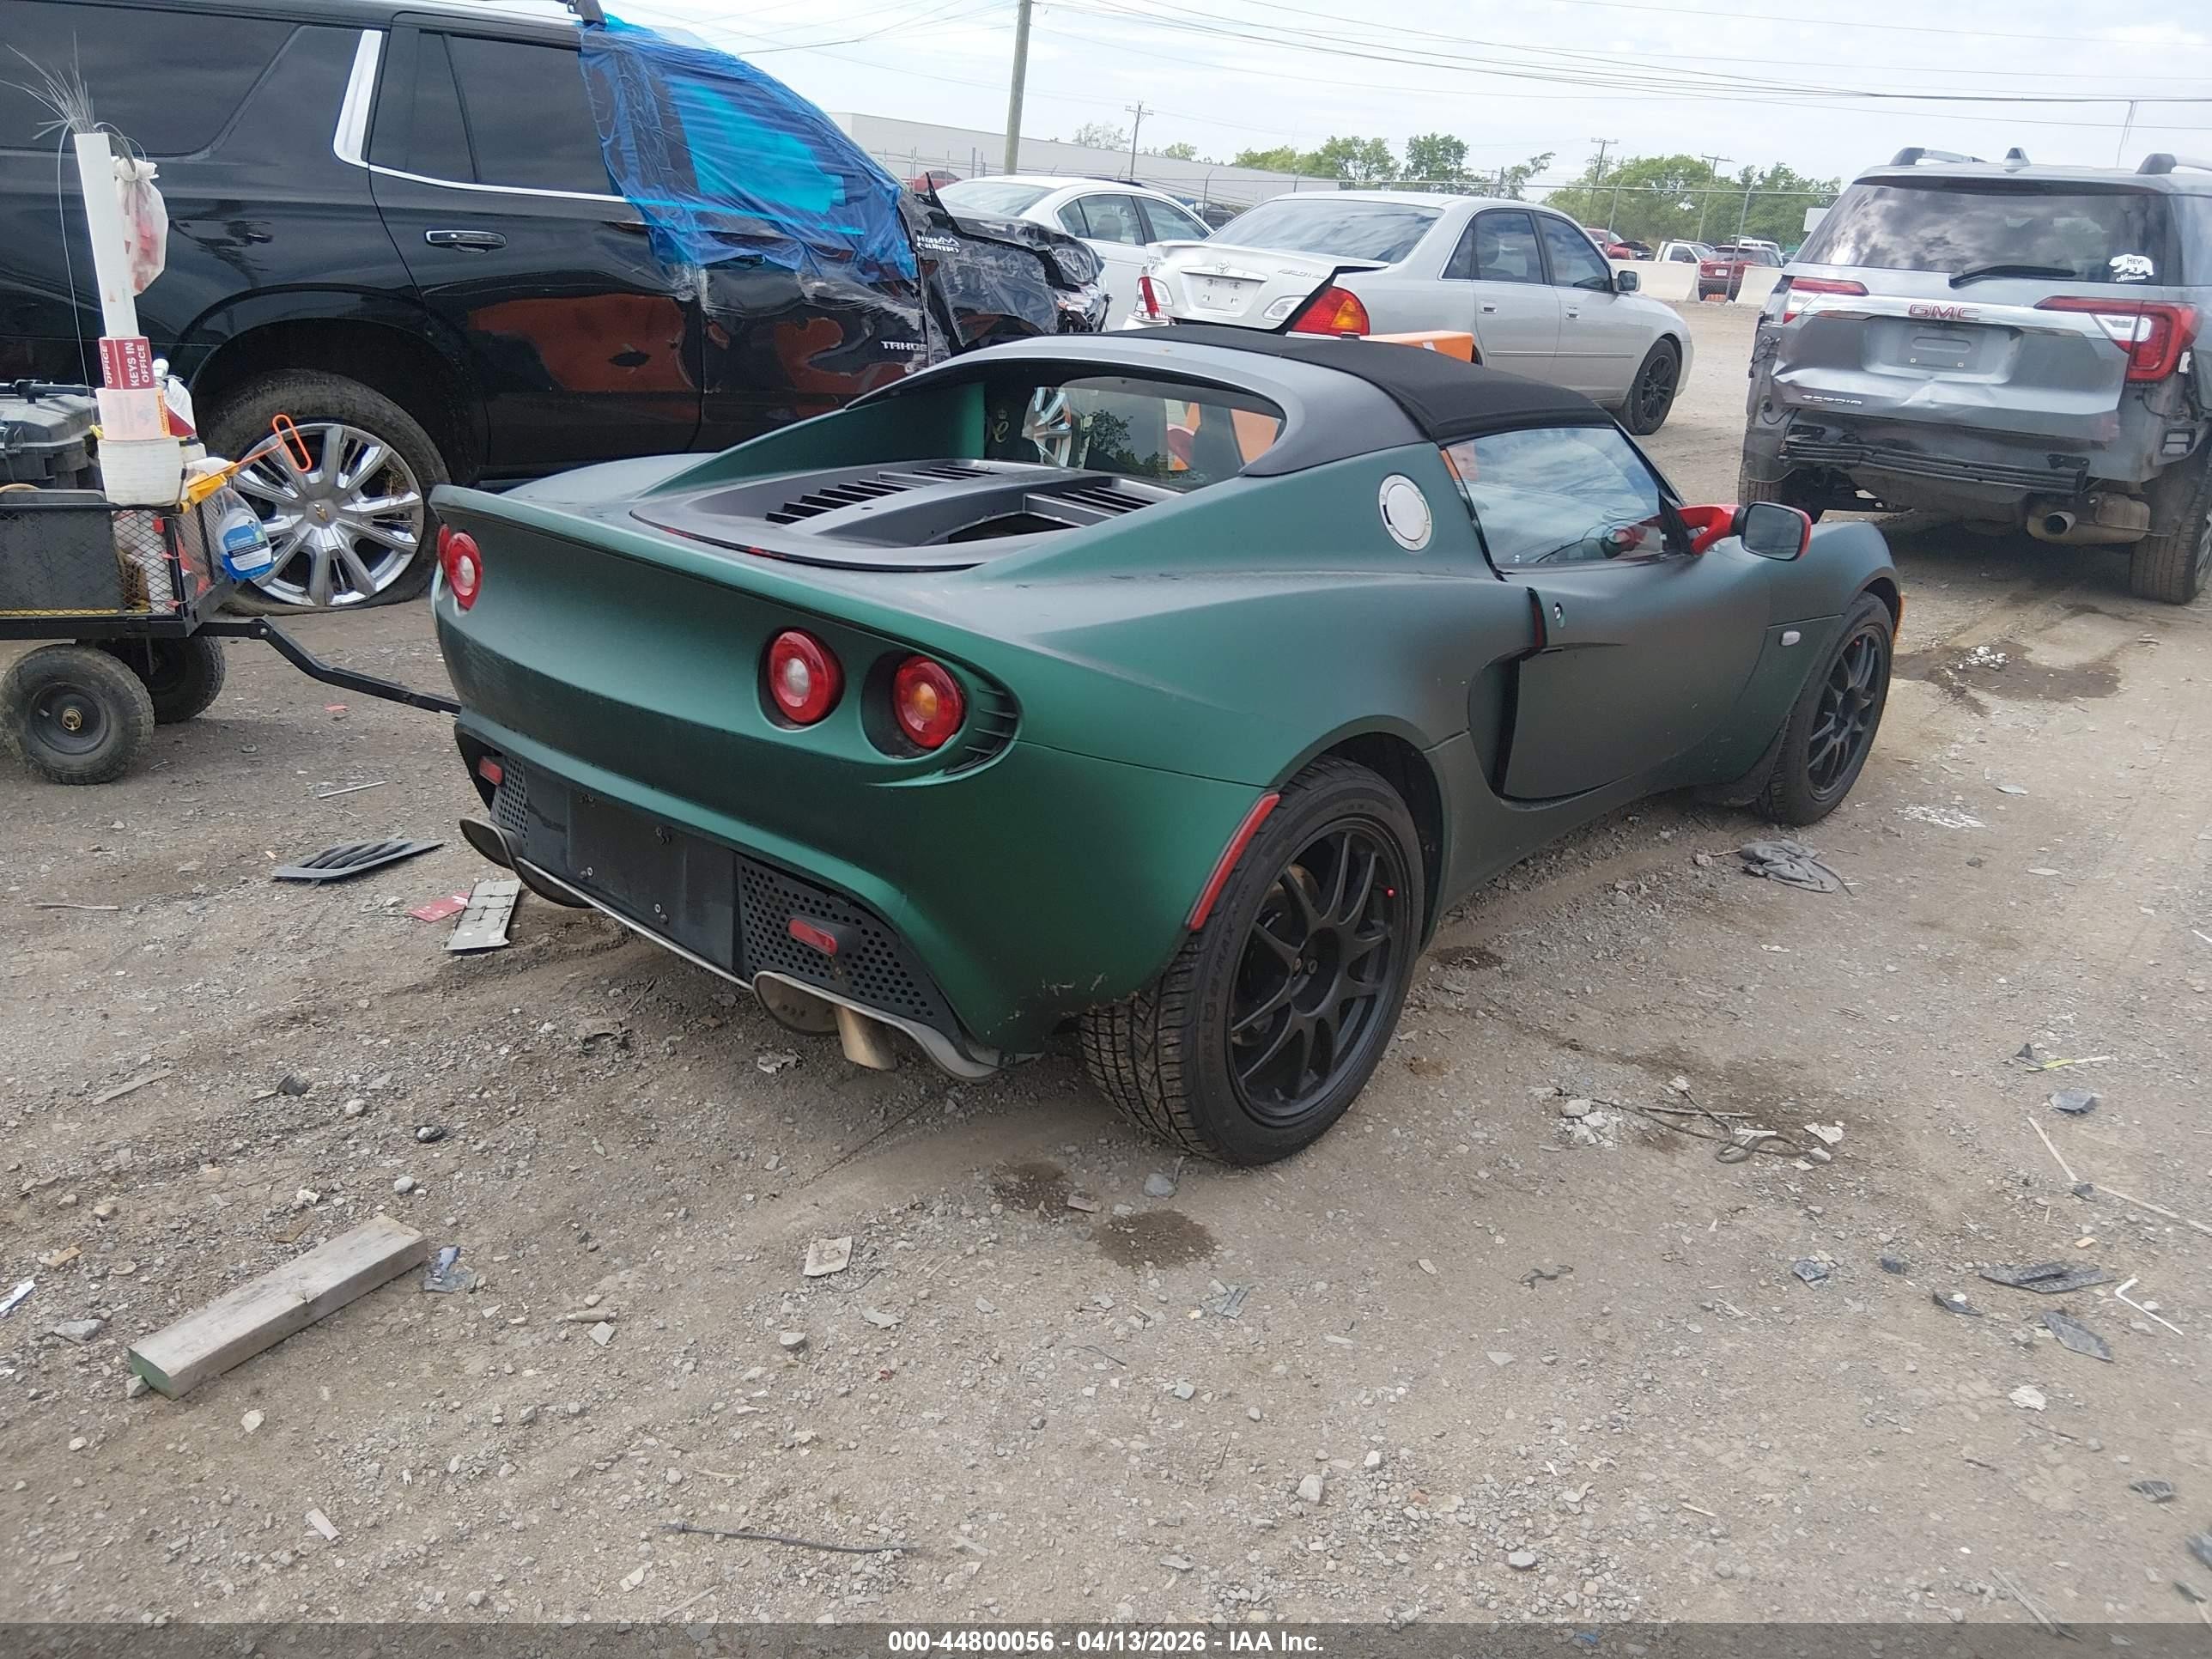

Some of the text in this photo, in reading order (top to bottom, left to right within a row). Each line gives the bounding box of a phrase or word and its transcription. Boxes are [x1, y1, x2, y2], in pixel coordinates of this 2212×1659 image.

[1908, 303, 1979, 322] GMC
[125, 342, 139, 386] KEYS IN
[137, 344, 149, 383] OFFICE
